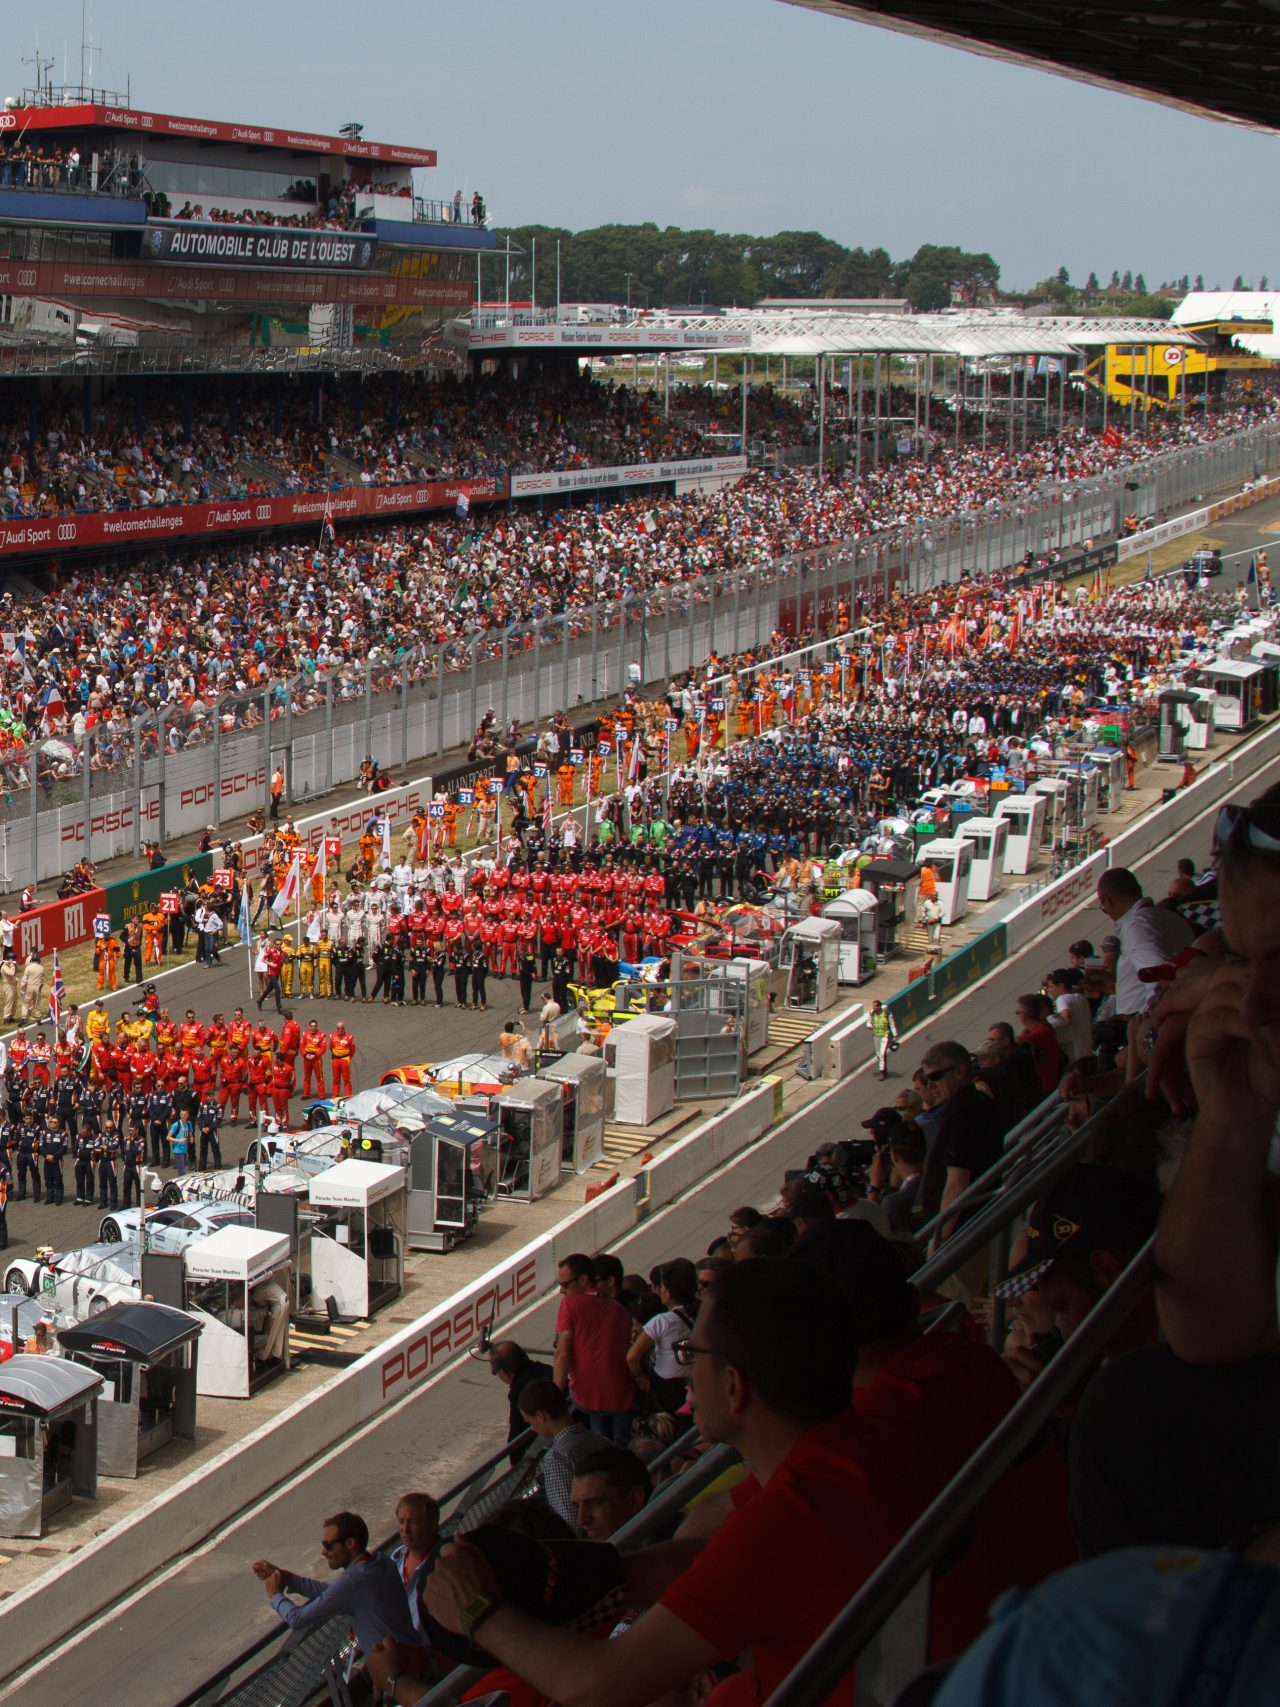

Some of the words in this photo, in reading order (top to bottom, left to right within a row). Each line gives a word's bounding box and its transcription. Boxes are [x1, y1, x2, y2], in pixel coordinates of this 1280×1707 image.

[170, 232, 254, 257] AUTOMOBILE
[257, 238, 289, 259] CLUB
[291, 242, 308, 260] DE
[310, 242, 356, 263] L'OUEST
[63, 272, 145, 290] #welcomechallenges
[1167, 352, 1180, 360] D
[516, 478, 552, 490] PORSCHE
[216, 510, 231, 522] Audi
[232, 508, 251, 523] Sport
[103, 515, 183, 533] #welcomechallenges
[6, 529, 26, 543] Audi
[27, 527, 51, 544] Sport
[840, 656, 851, 666] 41
[823, 665, 834, 674] 38
[712, 702, 724, 711] 48
[615, 731, 628, 740] 29
[600, 745, 611, 754] 27
[570, 754, 583, 764] 42
[534, 768, 546, 777] 37
[181, 767, 266, 810] PORSCHE
[460, 793, 472, 804] 31
[430, 805, 445, 816] 40
[61, 800, 160, 842] PORSCHE
[328, 843, 337, 853] 4
[215, 875, 231, 887] 23
[825, 888, 840, 897] PIT
[1042, 867, 1093, 921] PORSCHE
[124, 901, 150, 920] ROLEX
[162, 900, 176, 911] 21
[64, 901, 87, 942] RTL
[96, 921, 110, 933] 45
[21, 917, 45, 957] RTL
[383, 1260, 536, 1399] PORSCHE
[4, 1400, 25, 1409] racing
